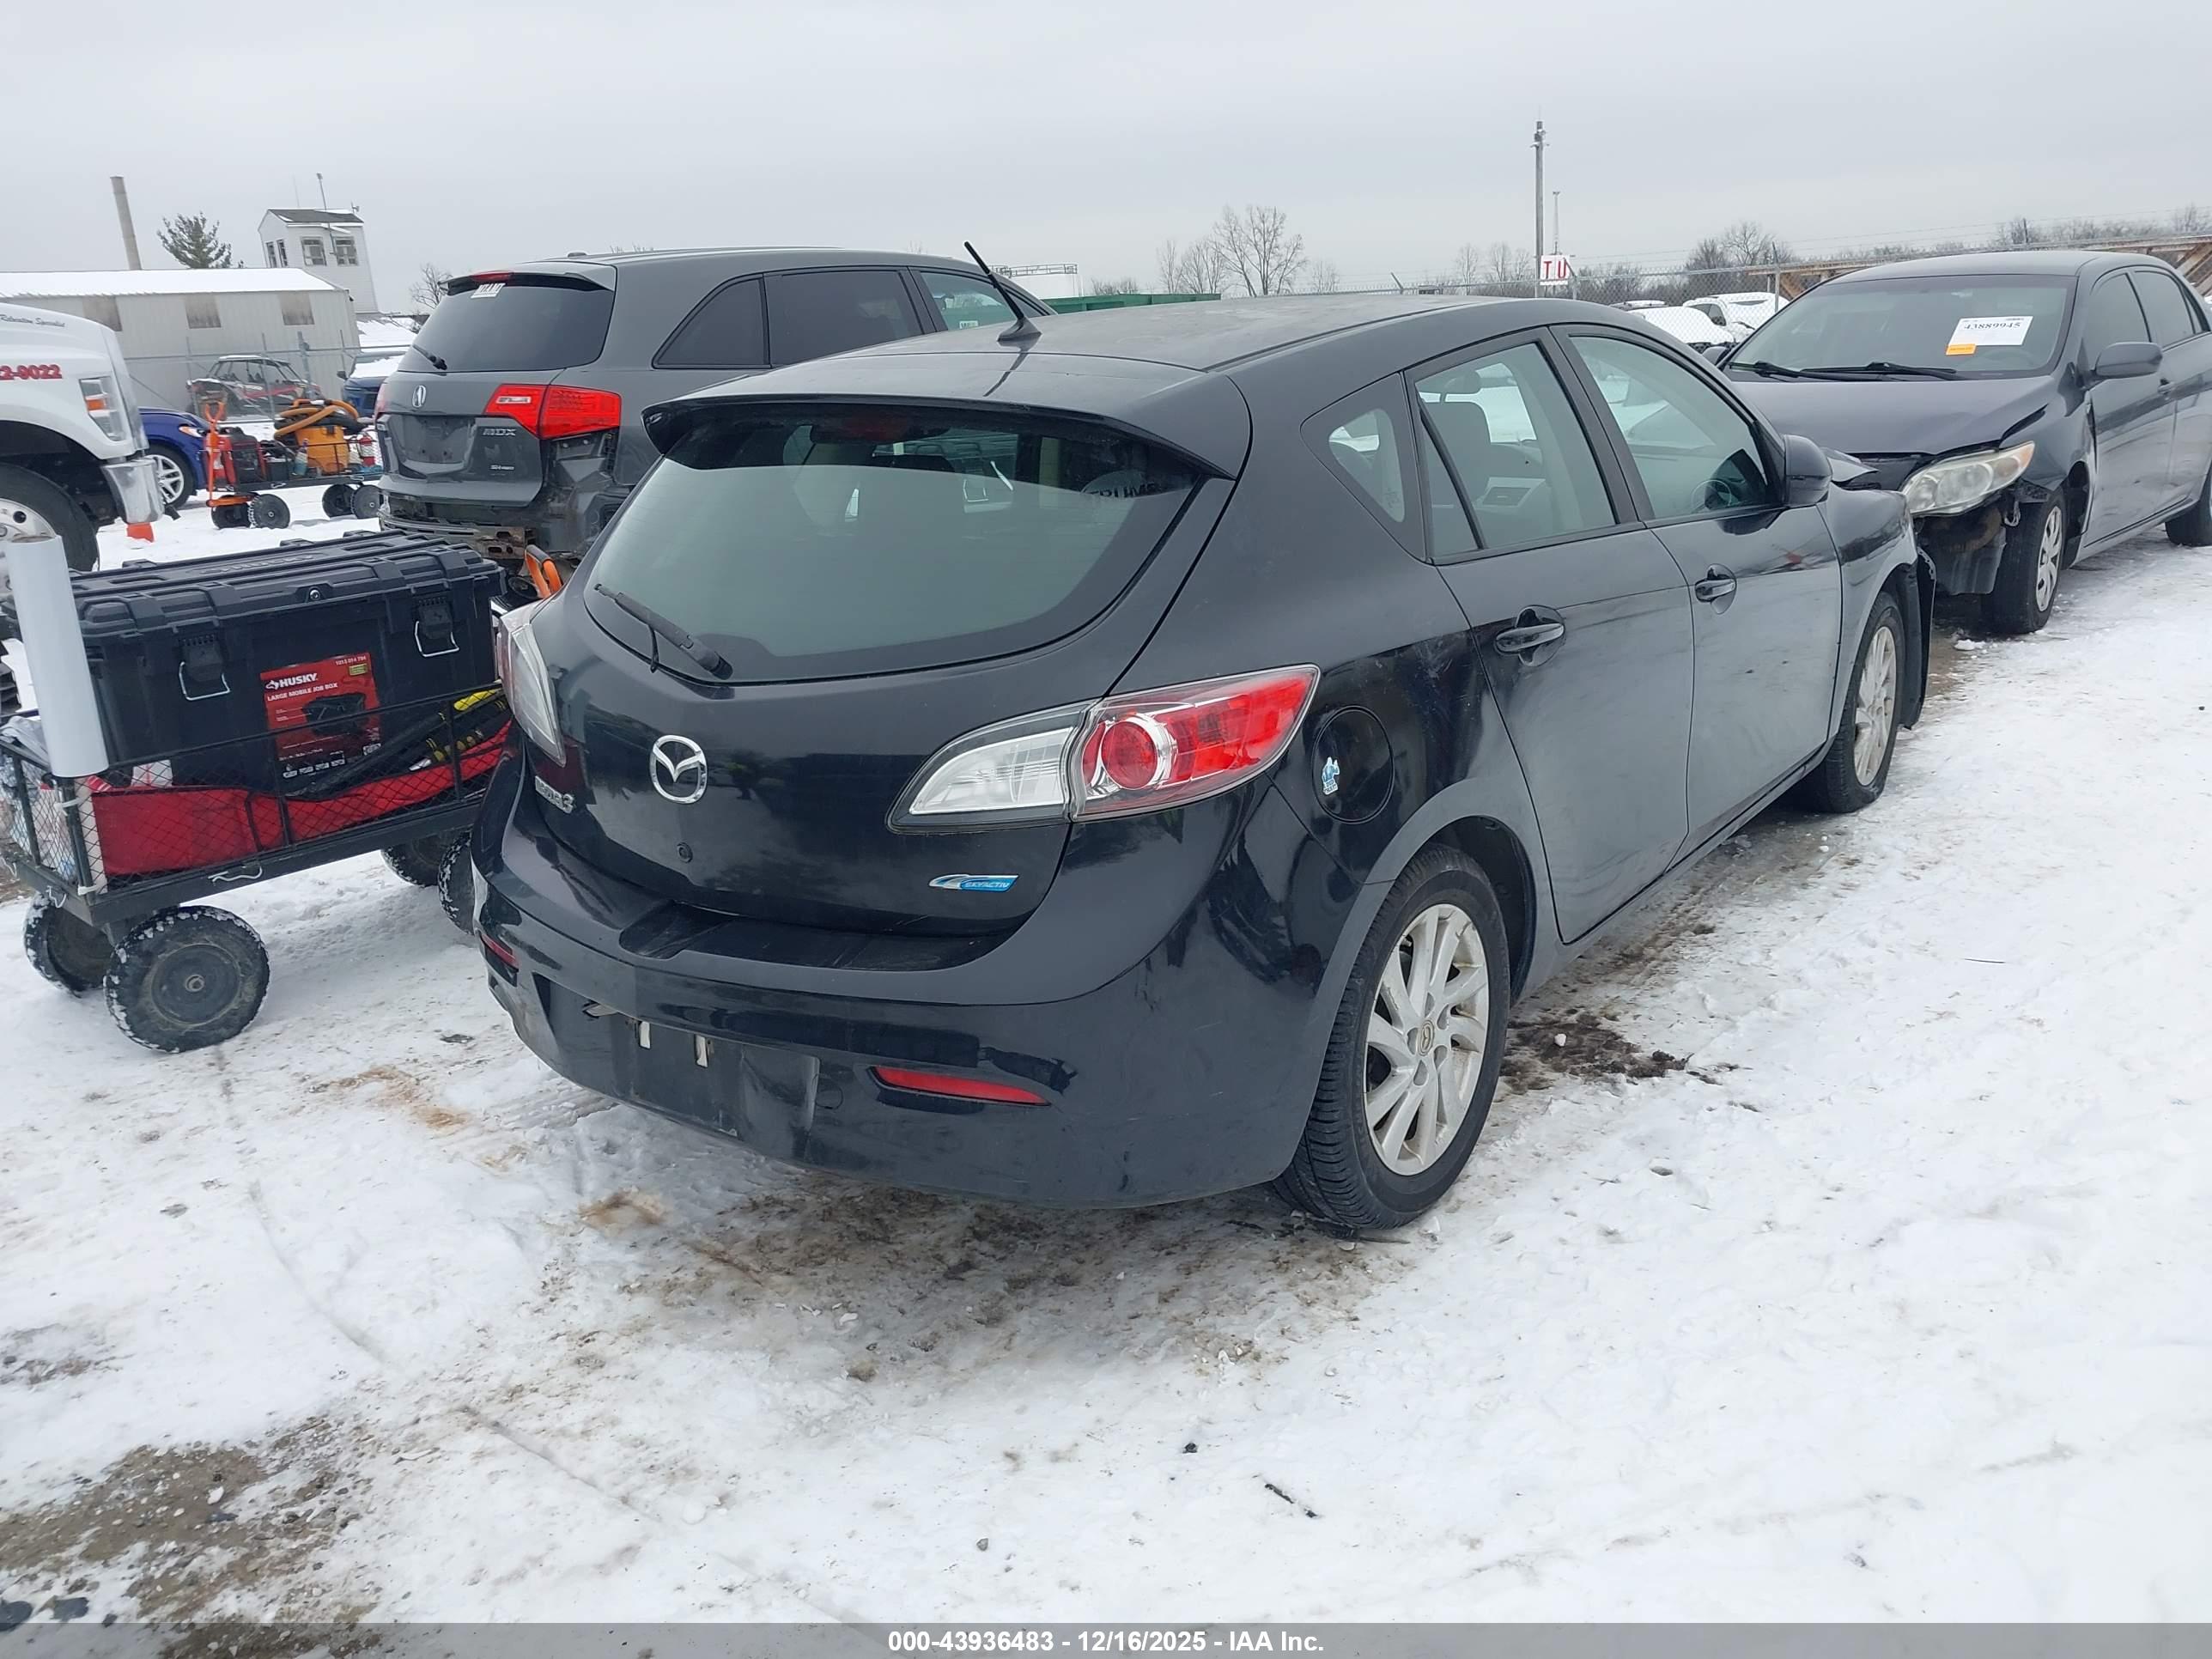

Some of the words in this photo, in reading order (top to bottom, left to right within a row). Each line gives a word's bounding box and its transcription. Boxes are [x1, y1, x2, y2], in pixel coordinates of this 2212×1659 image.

[279, 672, 319, 688] HUSKY
[267, 692, 289, 702] LARGE
[289, 687, 312, 697] MOBILE
[313, 684, 324, 693] JOB
